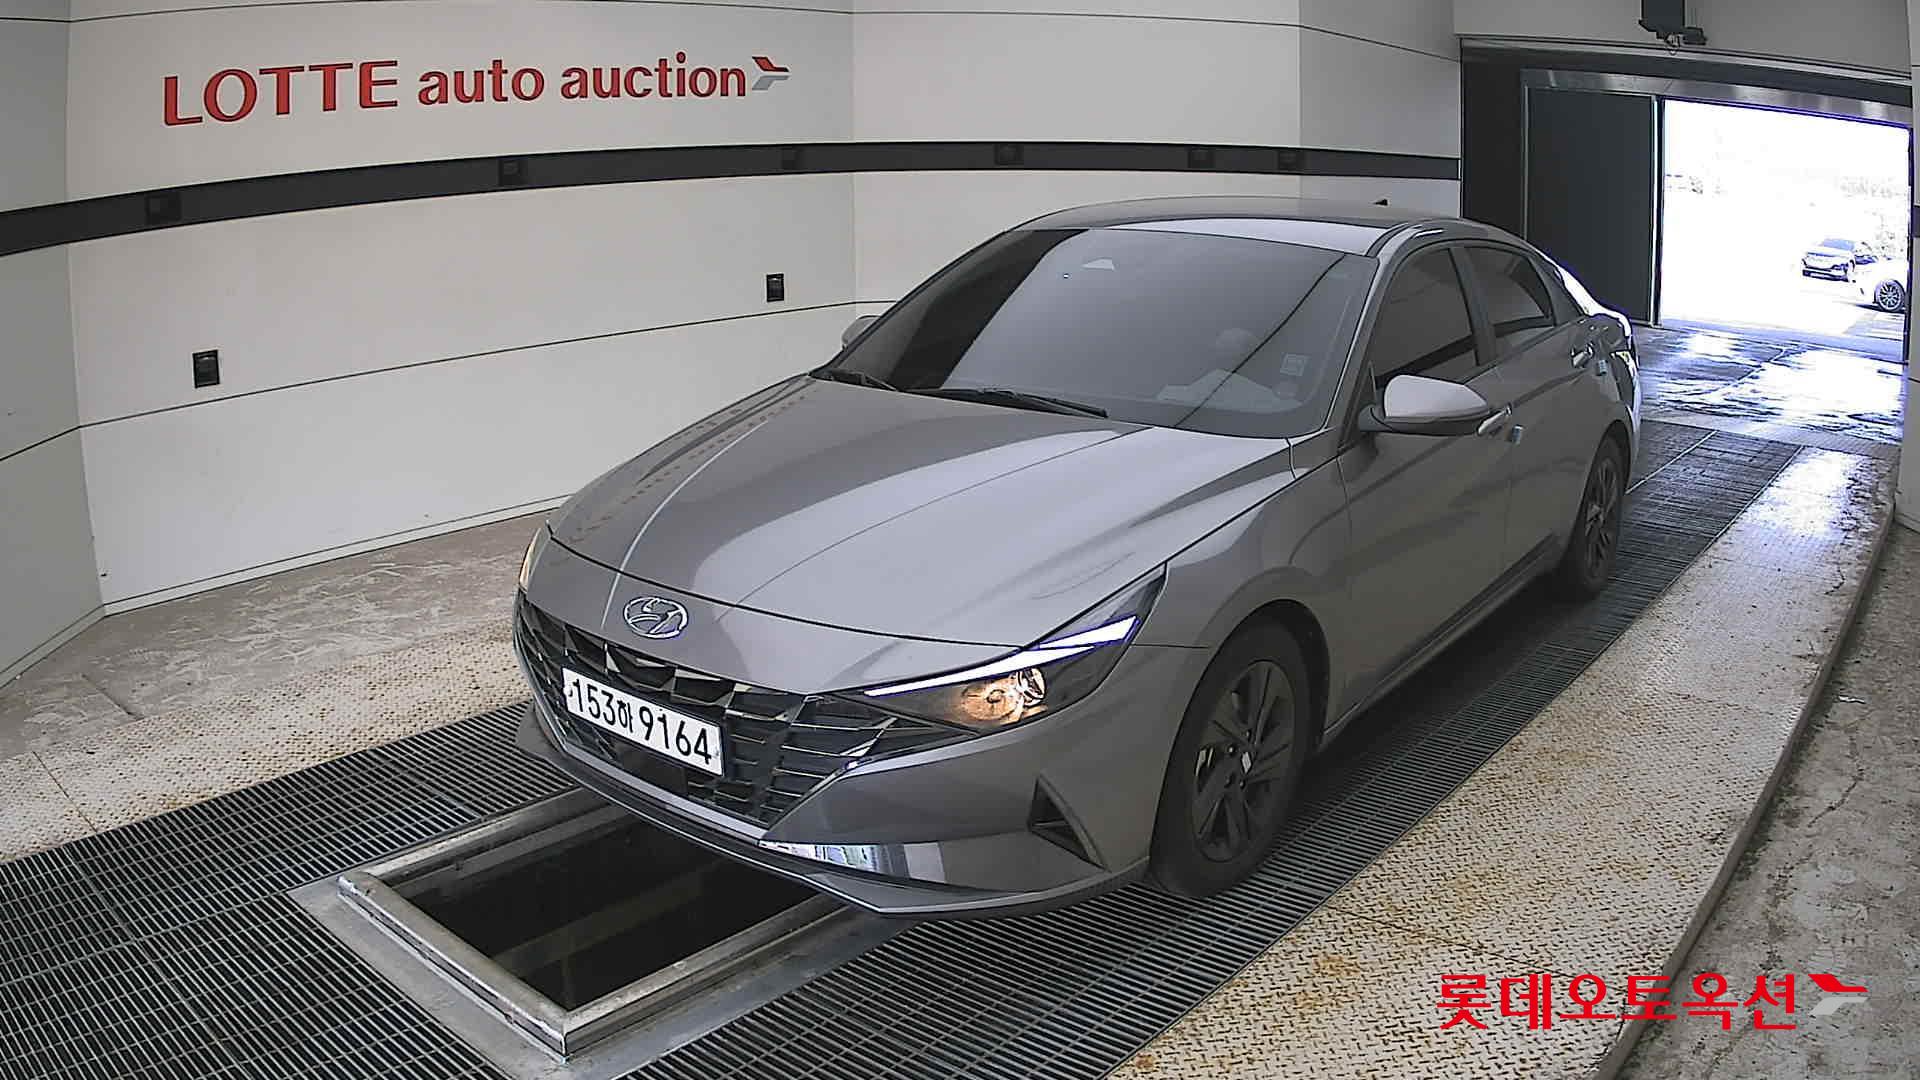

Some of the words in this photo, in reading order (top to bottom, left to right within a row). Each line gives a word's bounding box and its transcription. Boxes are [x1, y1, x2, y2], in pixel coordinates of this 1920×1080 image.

[163, 59, 399, 126] LOTTE
[417, 59, 546, 106] auto
[560, 51, 747, 98] auction
